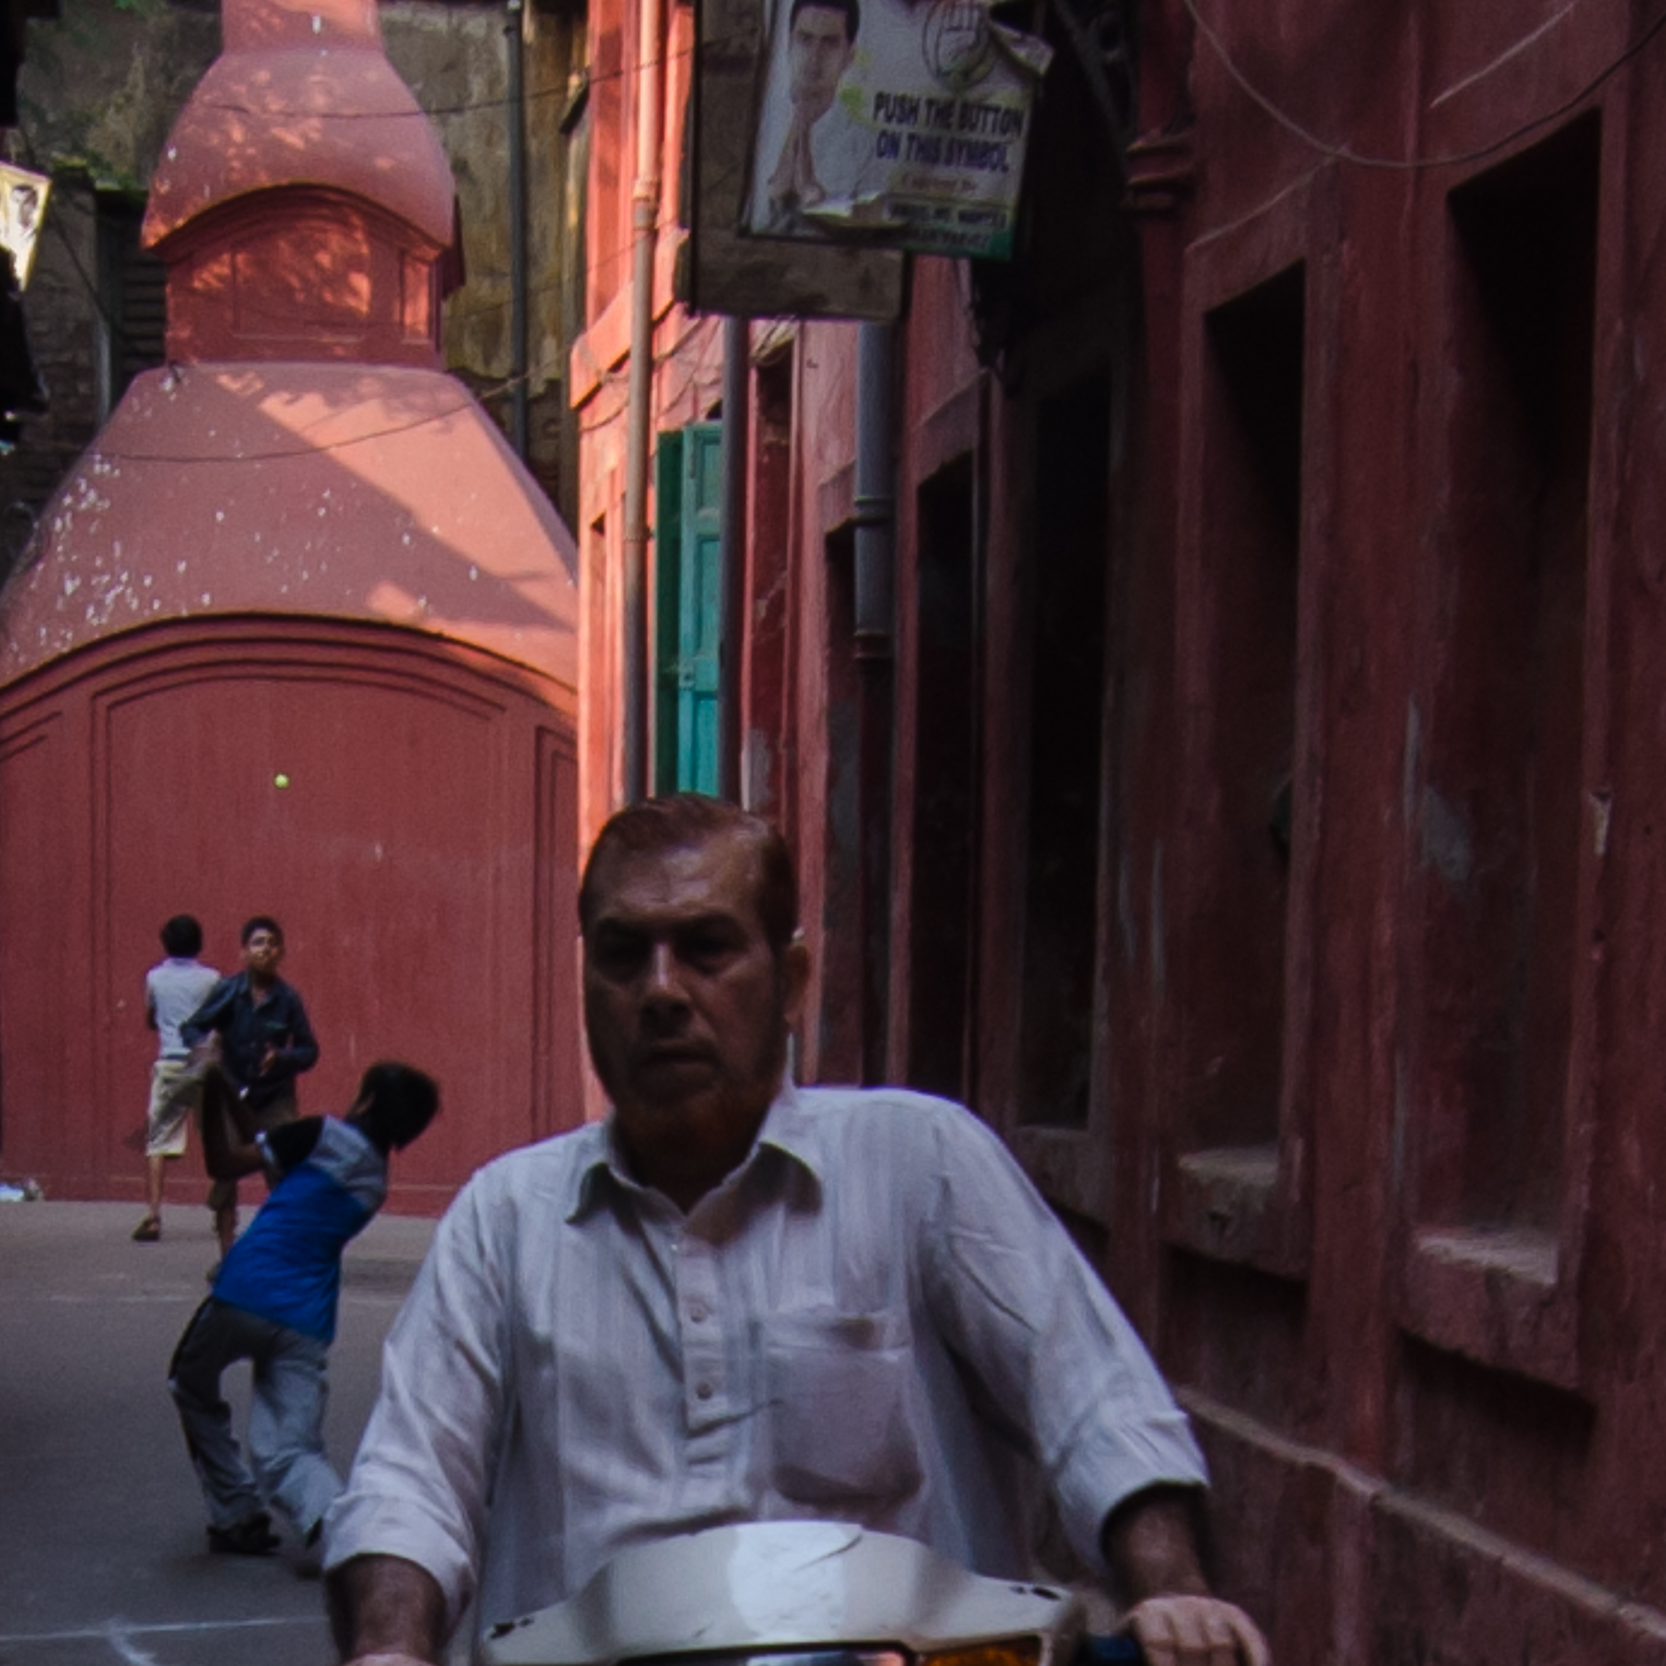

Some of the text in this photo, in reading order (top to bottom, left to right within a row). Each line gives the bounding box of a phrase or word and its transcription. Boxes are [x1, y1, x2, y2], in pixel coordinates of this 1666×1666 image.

[873, 91, 1024, 137] PUSH THE BUTTON
[875, 129, 1010, 174] ON THIS SYMBOL
